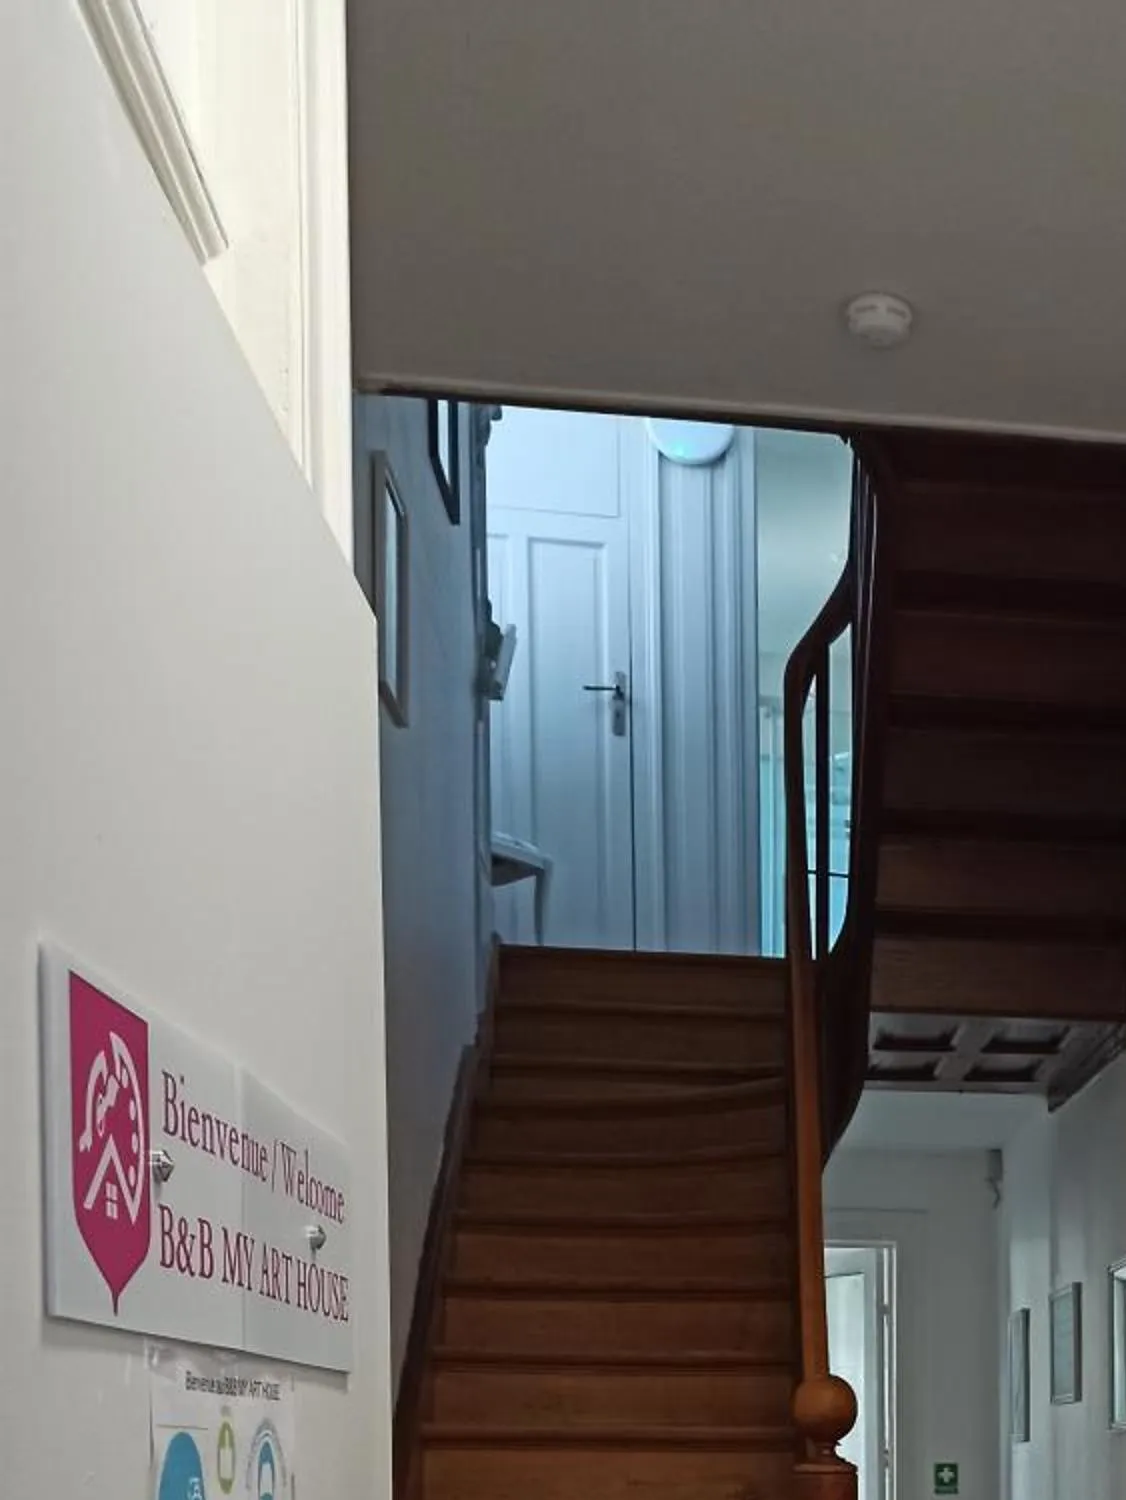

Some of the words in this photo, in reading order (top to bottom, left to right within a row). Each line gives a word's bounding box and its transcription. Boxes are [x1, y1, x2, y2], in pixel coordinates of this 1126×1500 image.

[161, 1068, 269, 1183] Bienvenue
[280, 1141, 346, 1225] Welcome
[158, 1203, 214, 1280] B&B
[221, 1226, 255, 1291] MY
[258, 1242, 293, 1306] ART
[296, 1258, 349, 1322] HOUSE
